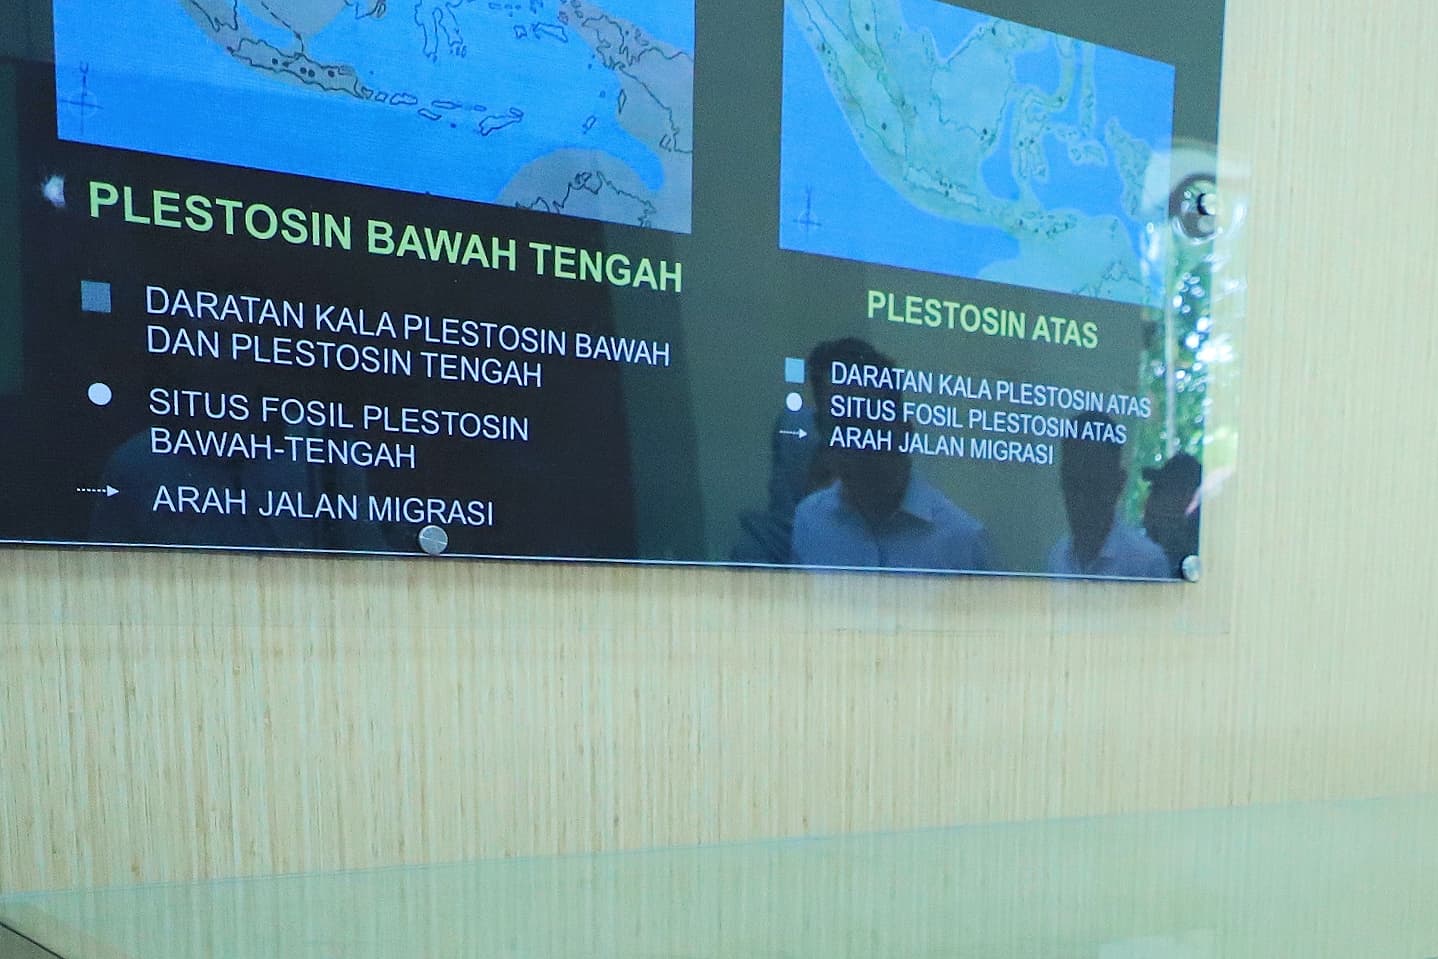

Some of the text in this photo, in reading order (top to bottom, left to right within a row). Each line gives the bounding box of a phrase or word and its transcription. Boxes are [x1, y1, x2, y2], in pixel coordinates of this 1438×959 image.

[89, 181, 682, 292] PLESTOSIN BAWAH TENGAH
[146, 286, 670, 366] DARATAN KALA PLESTOSIN BAWAH
[868, 290, 1098, 349] PLESTOSIN ATAS
[147, 325, 542, 387] DAN PLESTOSIN TENGAH
[149, 388, 528, 441] SITUS FOSIL PLESTOSIN
[831, 361, 1151, 418] DARATAN KALA PLESTOSIN ATAS
[830, 395, 1127, 444] SITUS FOSIL PLESTOSIN ATAS
[830, 427, 1054, 465] ARAH JALAN MIGRASI
[150, 427, 415, 469] BAWAH-TENGAH
[152, 485, 493, 526] ARAH JALAN MIGRASI
